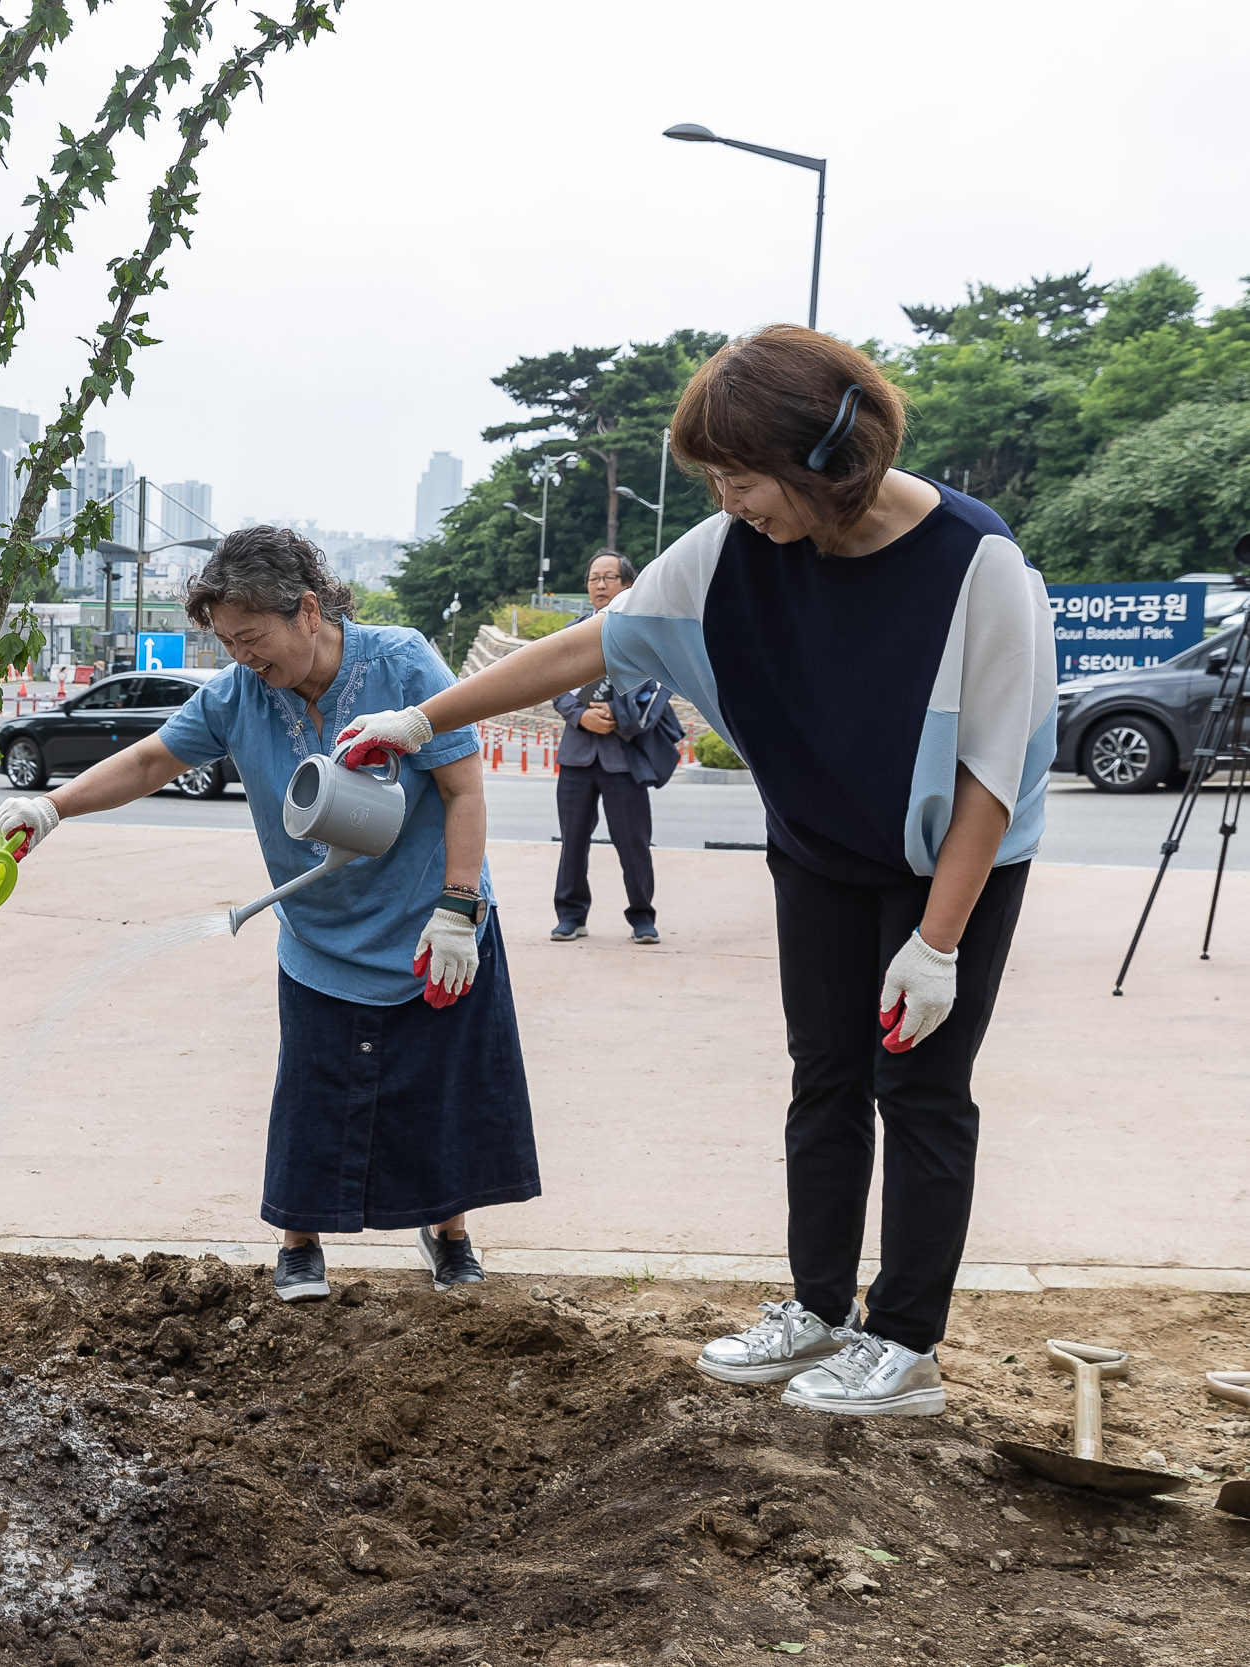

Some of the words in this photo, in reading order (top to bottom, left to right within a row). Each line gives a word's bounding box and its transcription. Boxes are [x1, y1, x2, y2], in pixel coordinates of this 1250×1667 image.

[1048, 593, 1187, 622] 구의야구공원
[1086, 626, 1140, 640] Baseball
[1143, 625, 1174, 640] Park
